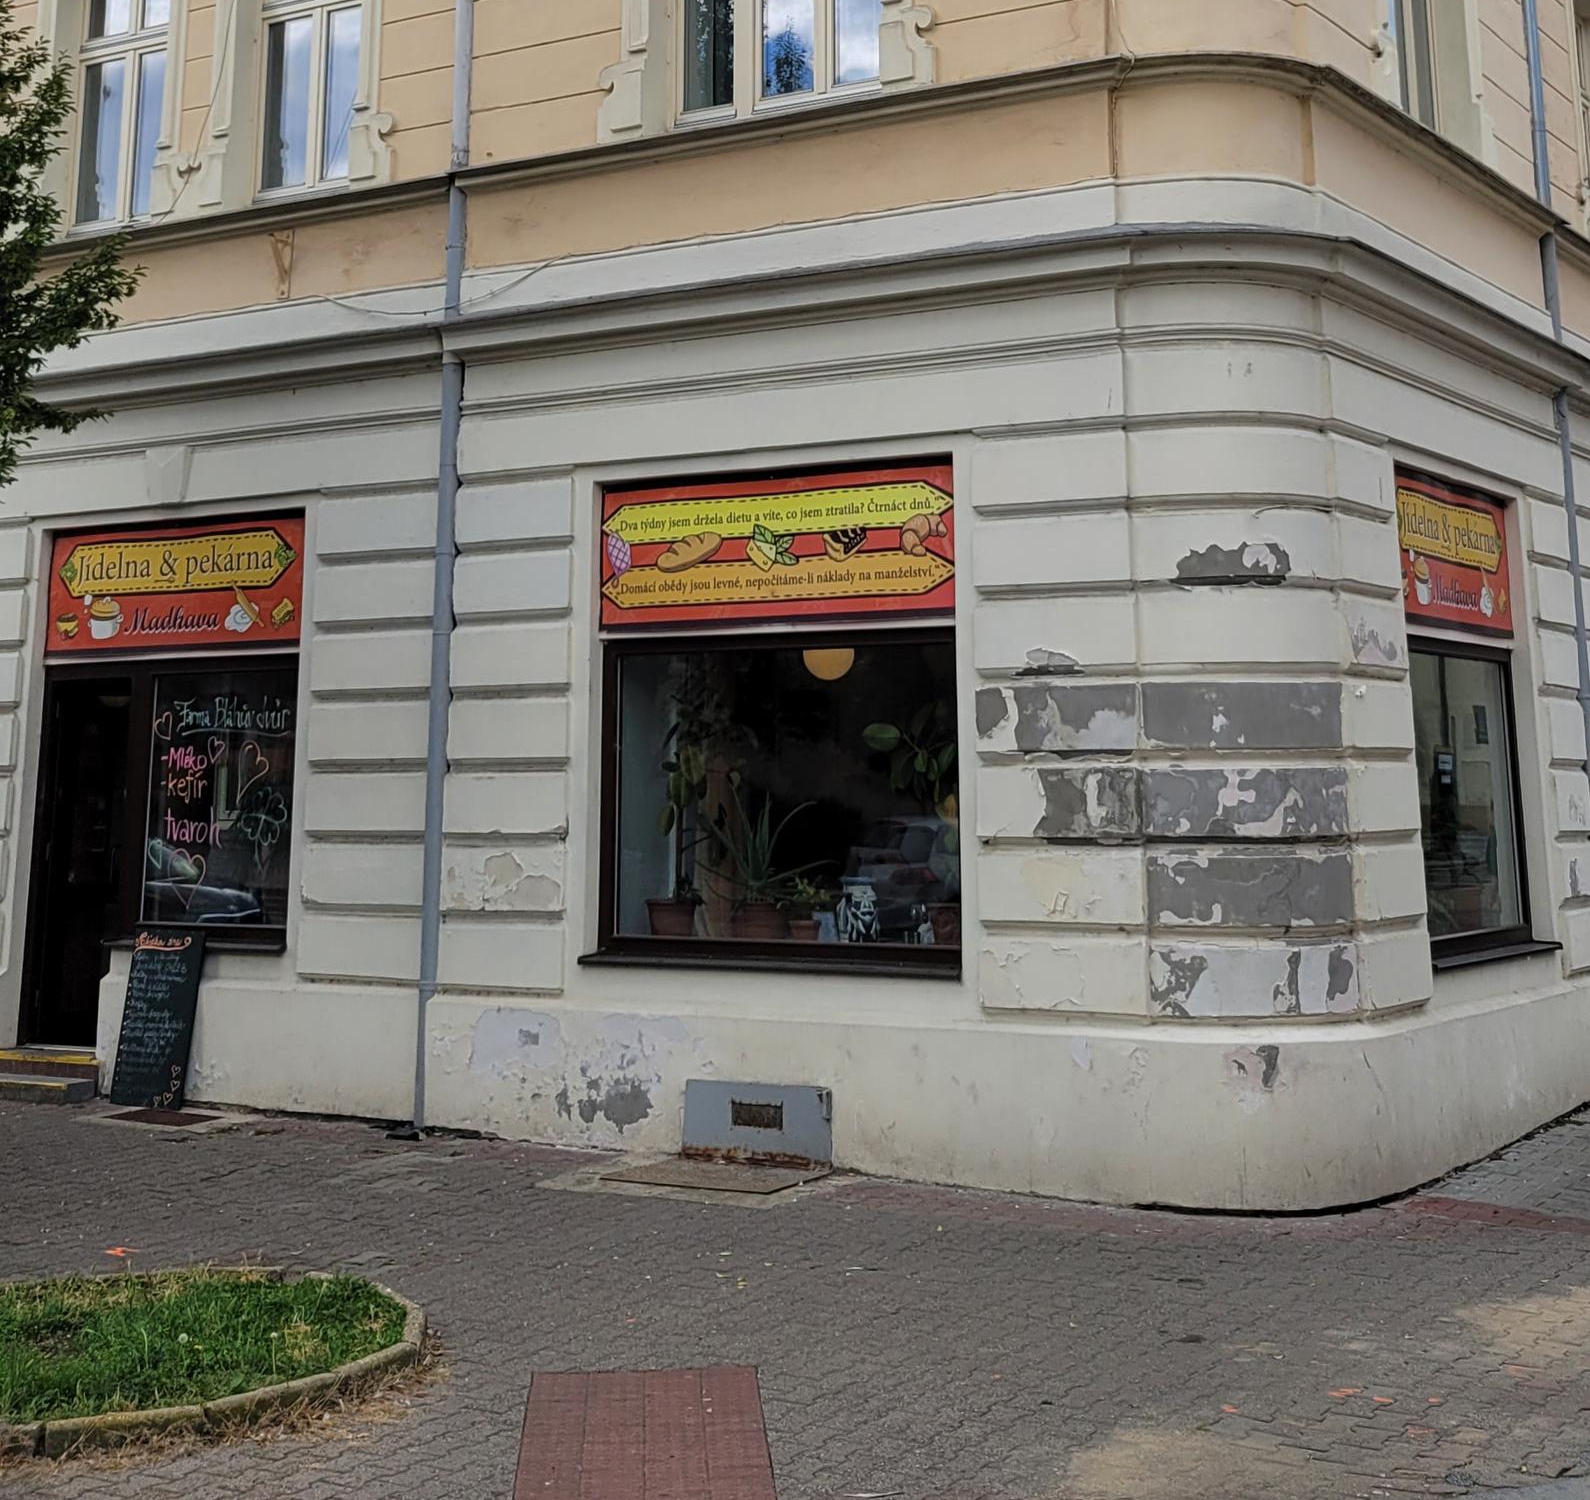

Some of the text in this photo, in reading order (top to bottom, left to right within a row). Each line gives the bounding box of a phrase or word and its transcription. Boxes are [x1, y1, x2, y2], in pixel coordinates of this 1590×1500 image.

[640, 517, 666, 534] týdny
[667, 514, 691, 531] jsem
[693, 511, 724, 526] držela
[726, 510, 752, 523] dietu
[754, 513, 761, 522] a
[763, 509, 784, 522] víte,
[785, 511, 798, 520] co
[799, 507, 823, 522] jsem
[825, 502, 865, 517] ztratila?
[867, 497, 907, 514] Čtrnáct
[1401, 501, 1496, 556] Jídelna & pekárna
[77, 543, 274, 588] Jídelna & pekárna
[658, 578, 688, 597] obědy
[689, 579, 711, 595] jsou
[713, 574, 743, 590] levné,
[745, 572, 814, 591] nepočítáme-li
[816, 569, 856, 586] náklady
[858, 571, 872, 581] na
[123, 606, 221, 637] Madhava
[164, 806, 222, 849] tvaroh
